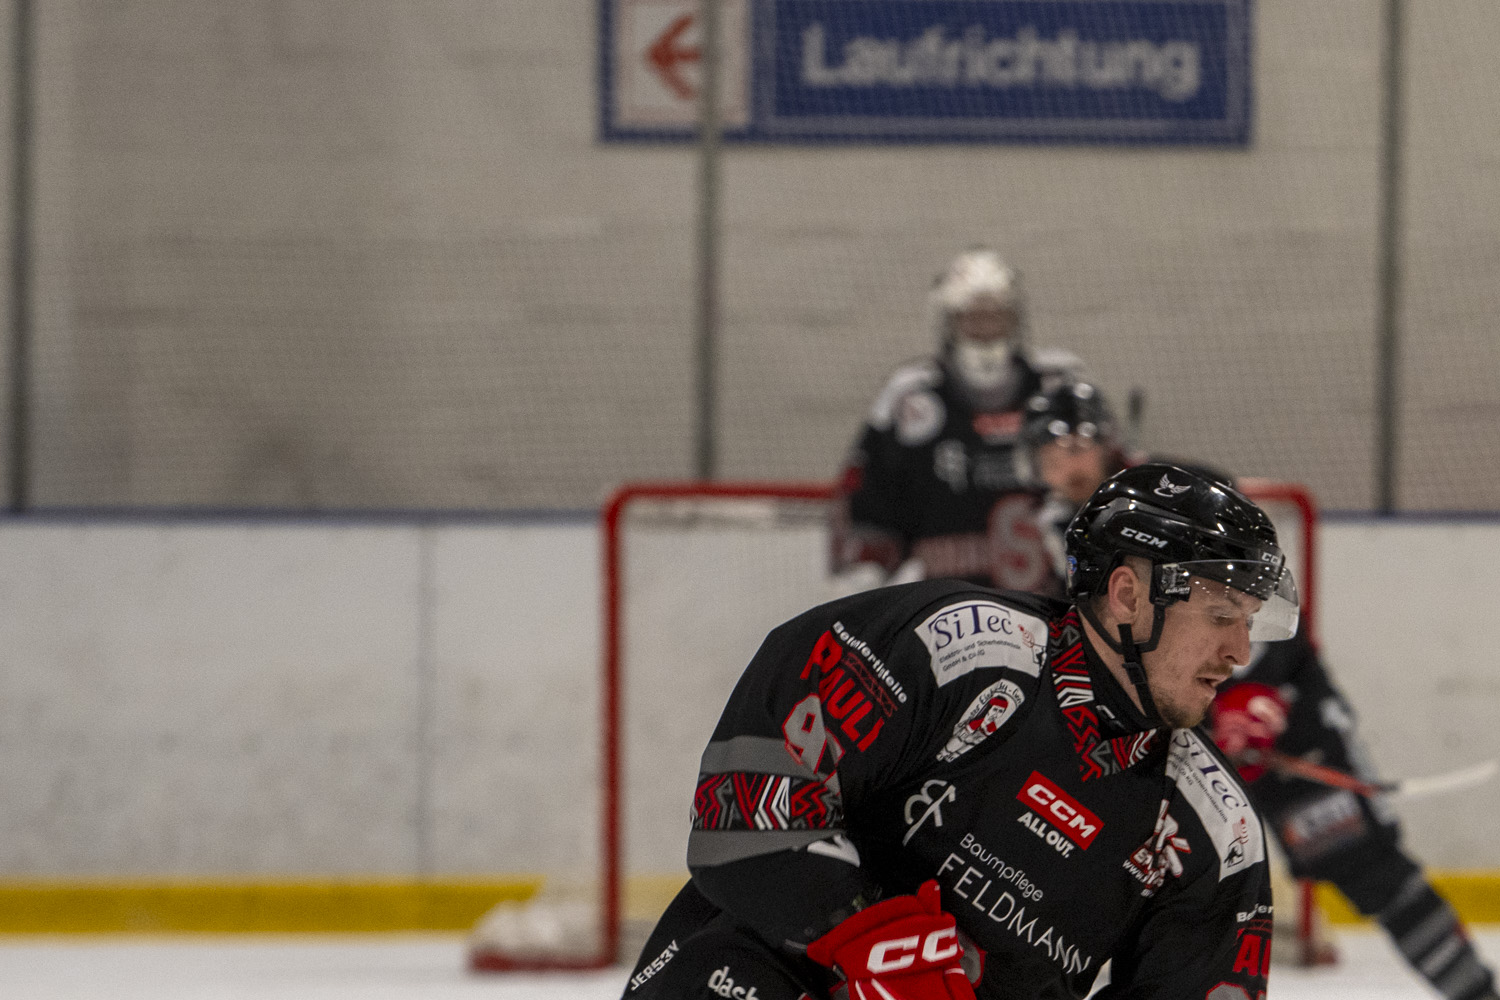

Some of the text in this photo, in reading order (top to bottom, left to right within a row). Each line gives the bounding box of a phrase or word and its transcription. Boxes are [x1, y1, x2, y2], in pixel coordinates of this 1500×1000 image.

[802, 23, 1201, 99] Laufrichtung
[1120, 527, 1168, 548] CCM
[1262, 552, 1281, 565] CC
[928, 604, 1013, 651] SiTec
[1017, 812, 1074, 858] ALL OUT.
[1027, 784, 1096, 838] CCM
[960, 833, 1044, 901] Baumpflege
[937, 853, 1091, 974] FELDMANN
[866, 926, 963, 974] CC
